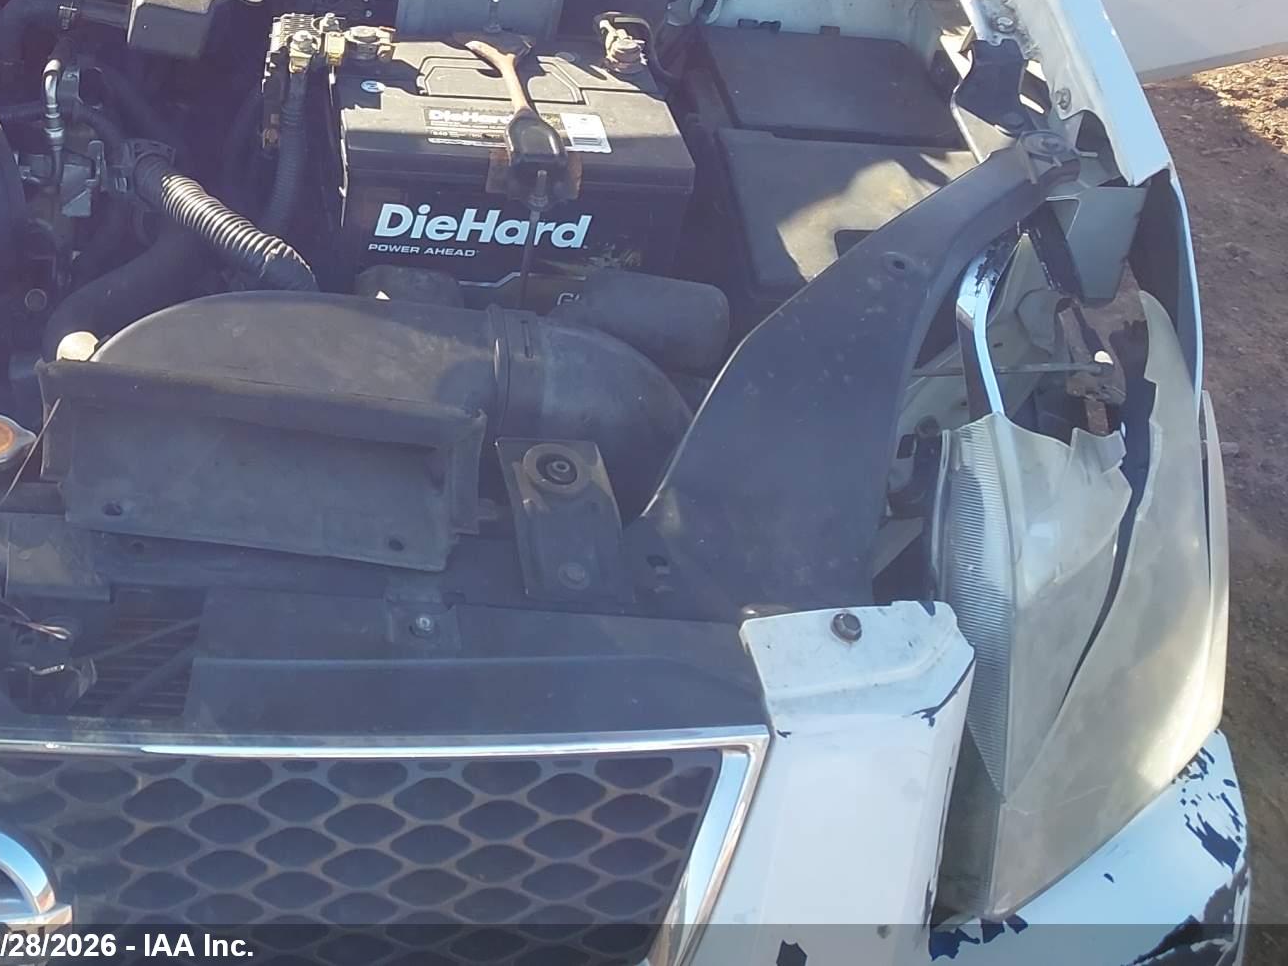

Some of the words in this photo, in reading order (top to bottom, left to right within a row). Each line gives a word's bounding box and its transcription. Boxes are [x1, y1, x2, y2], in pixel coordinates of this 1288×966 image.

[373, 202, 592, 250] DieHard
[367, 243, 421, 255] POWER
[423, 247, 477, 258] AHEAD
